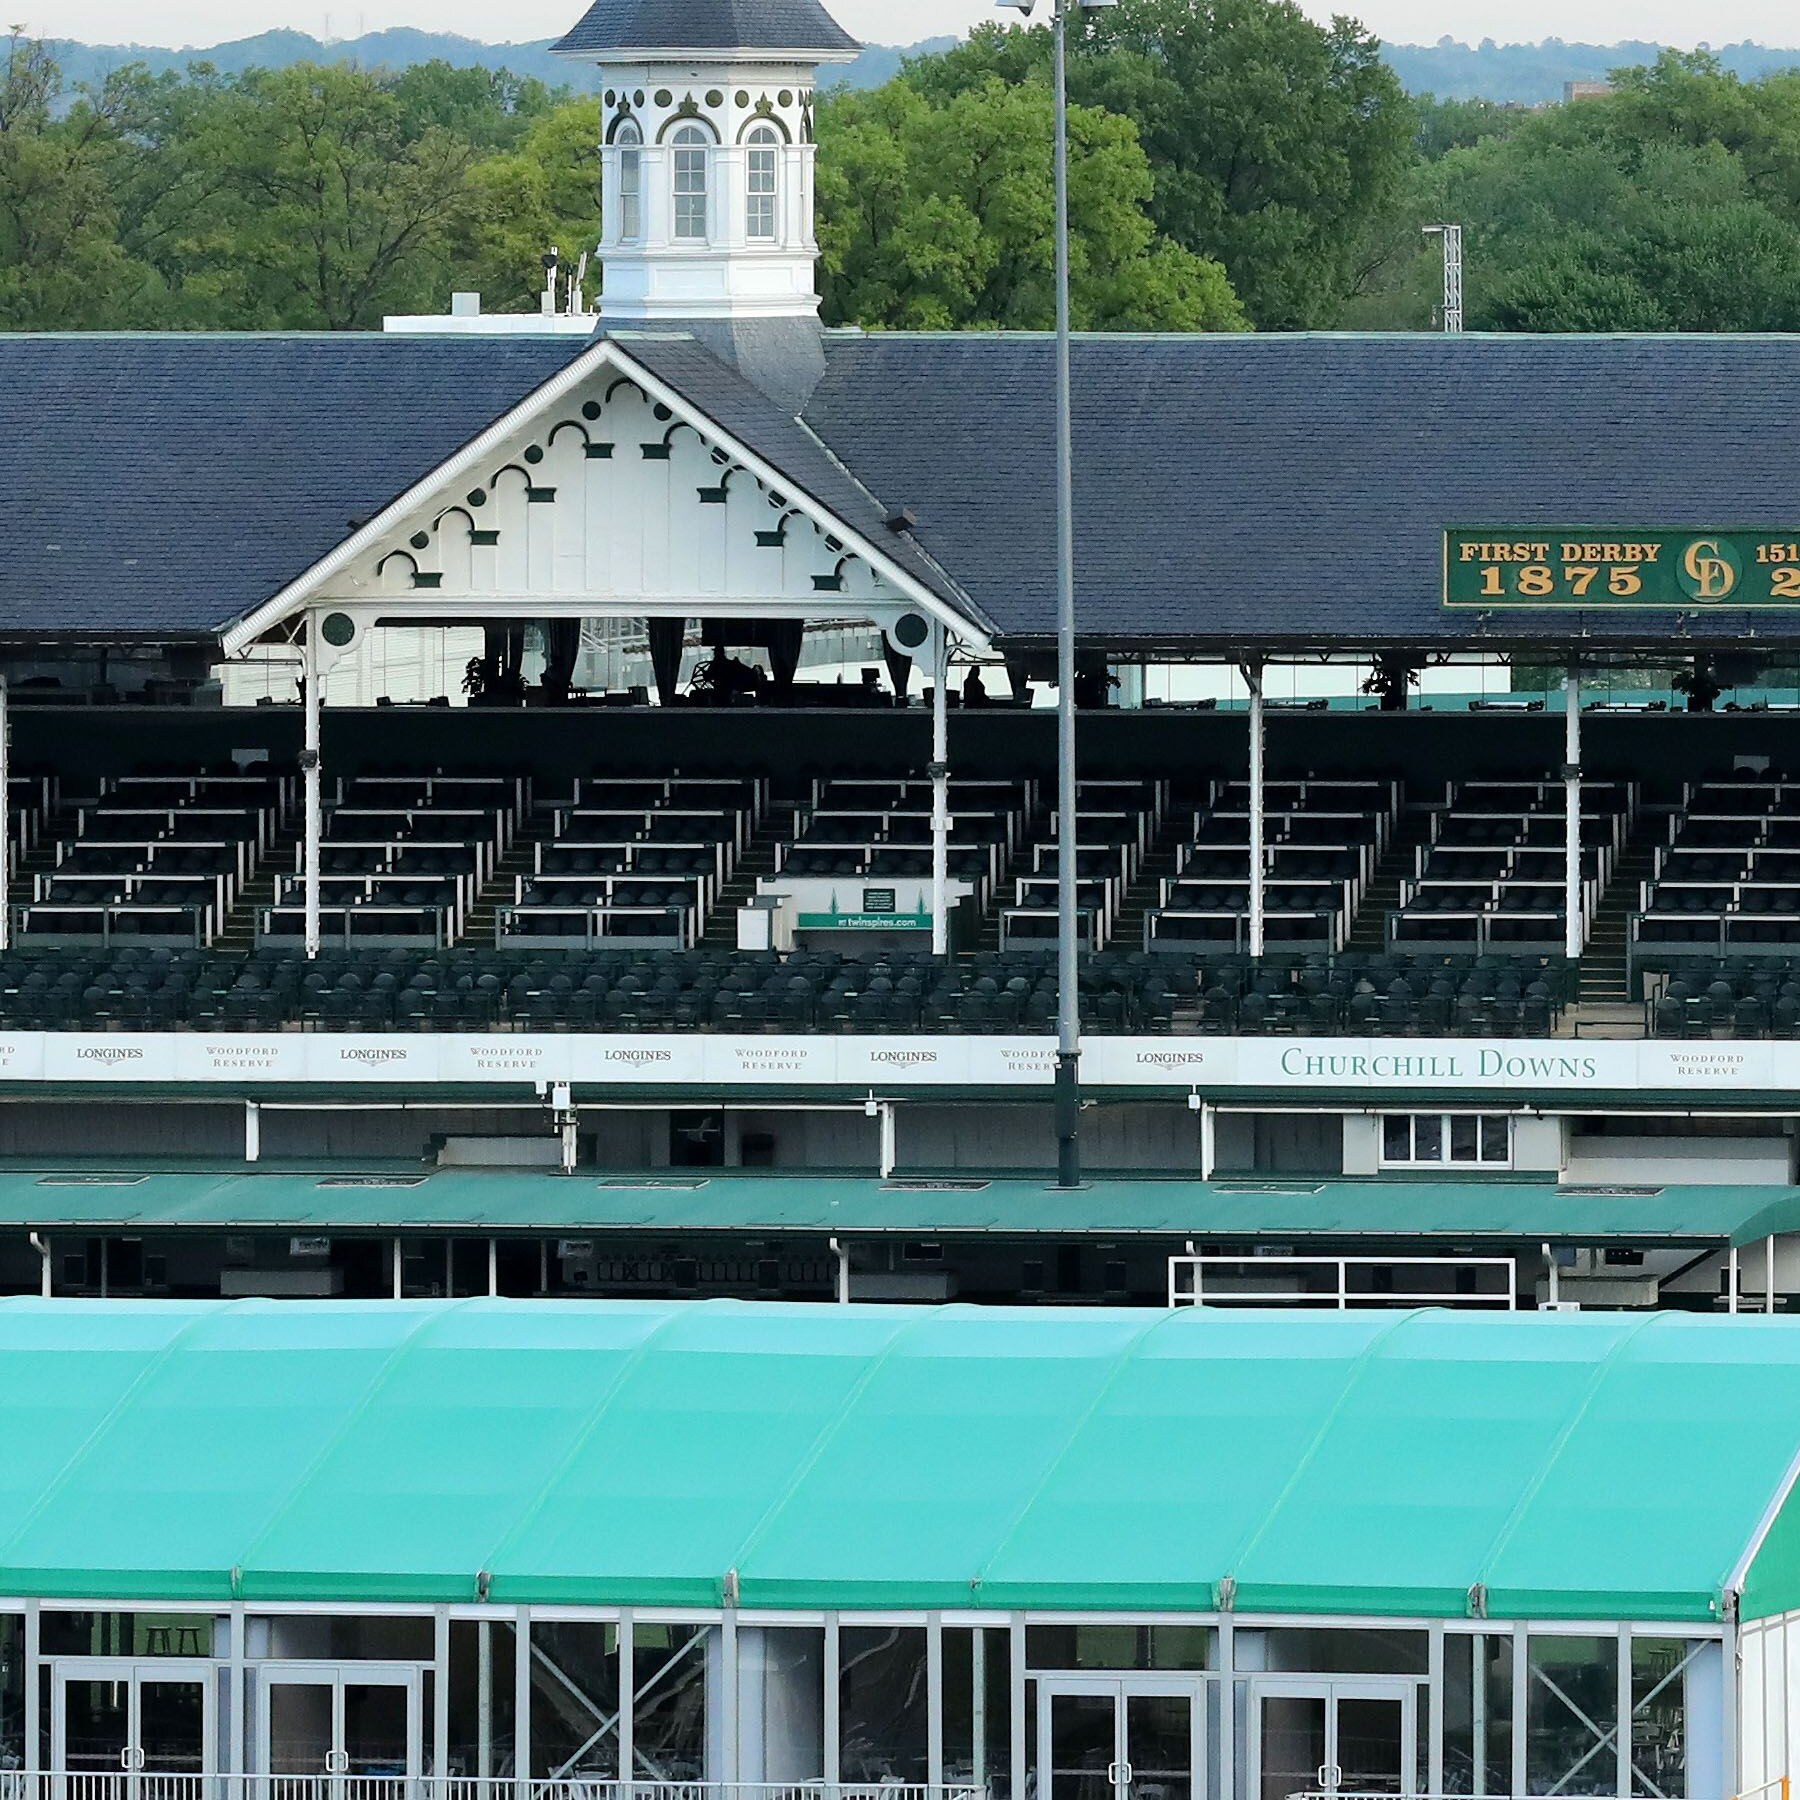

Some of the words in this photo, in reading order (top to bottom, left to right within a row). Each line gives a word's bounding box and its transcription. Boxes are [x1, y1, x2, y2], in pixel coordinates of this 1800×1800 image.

[1460, 543, 1550, 562] FIRST
[1561, 543, 1660, 562] DERBY
[1481, 565, 1642, 596] 1875
[76, 1048, 144, 1060] LONGINES
[206, 1046, 279, 1056] WOODFORD
[340, 1048, 407, 1060] LONGINES
[470, 1047, 543, 1056] WOODFORD
[604, 1049, 672, 1061] LONGINES
[734, 1049, 808, 1058] WOODFORD
[870, 1050, 938, 1062] LONGINES
[1000, 1049, 1057, 1059] WOODFO
[213, 1058, 271, 1067] RESERVE
[1136, 1052, 1204, 1064] LONGINES
[1282, 1048, 1462, 1076] CHURCHILL
[1480, 1050, 1595, 1077] DOWNS
[1669, 1054, 1744, 1063] WOODFORD
[477, 1059, 537, 1068] RESERVE
[742, 1061, 802, 1070] RESERVE
[1008, 1061, 1051, 1071] RESER
[1678, 1066, 1737, 1075] RESERVE
